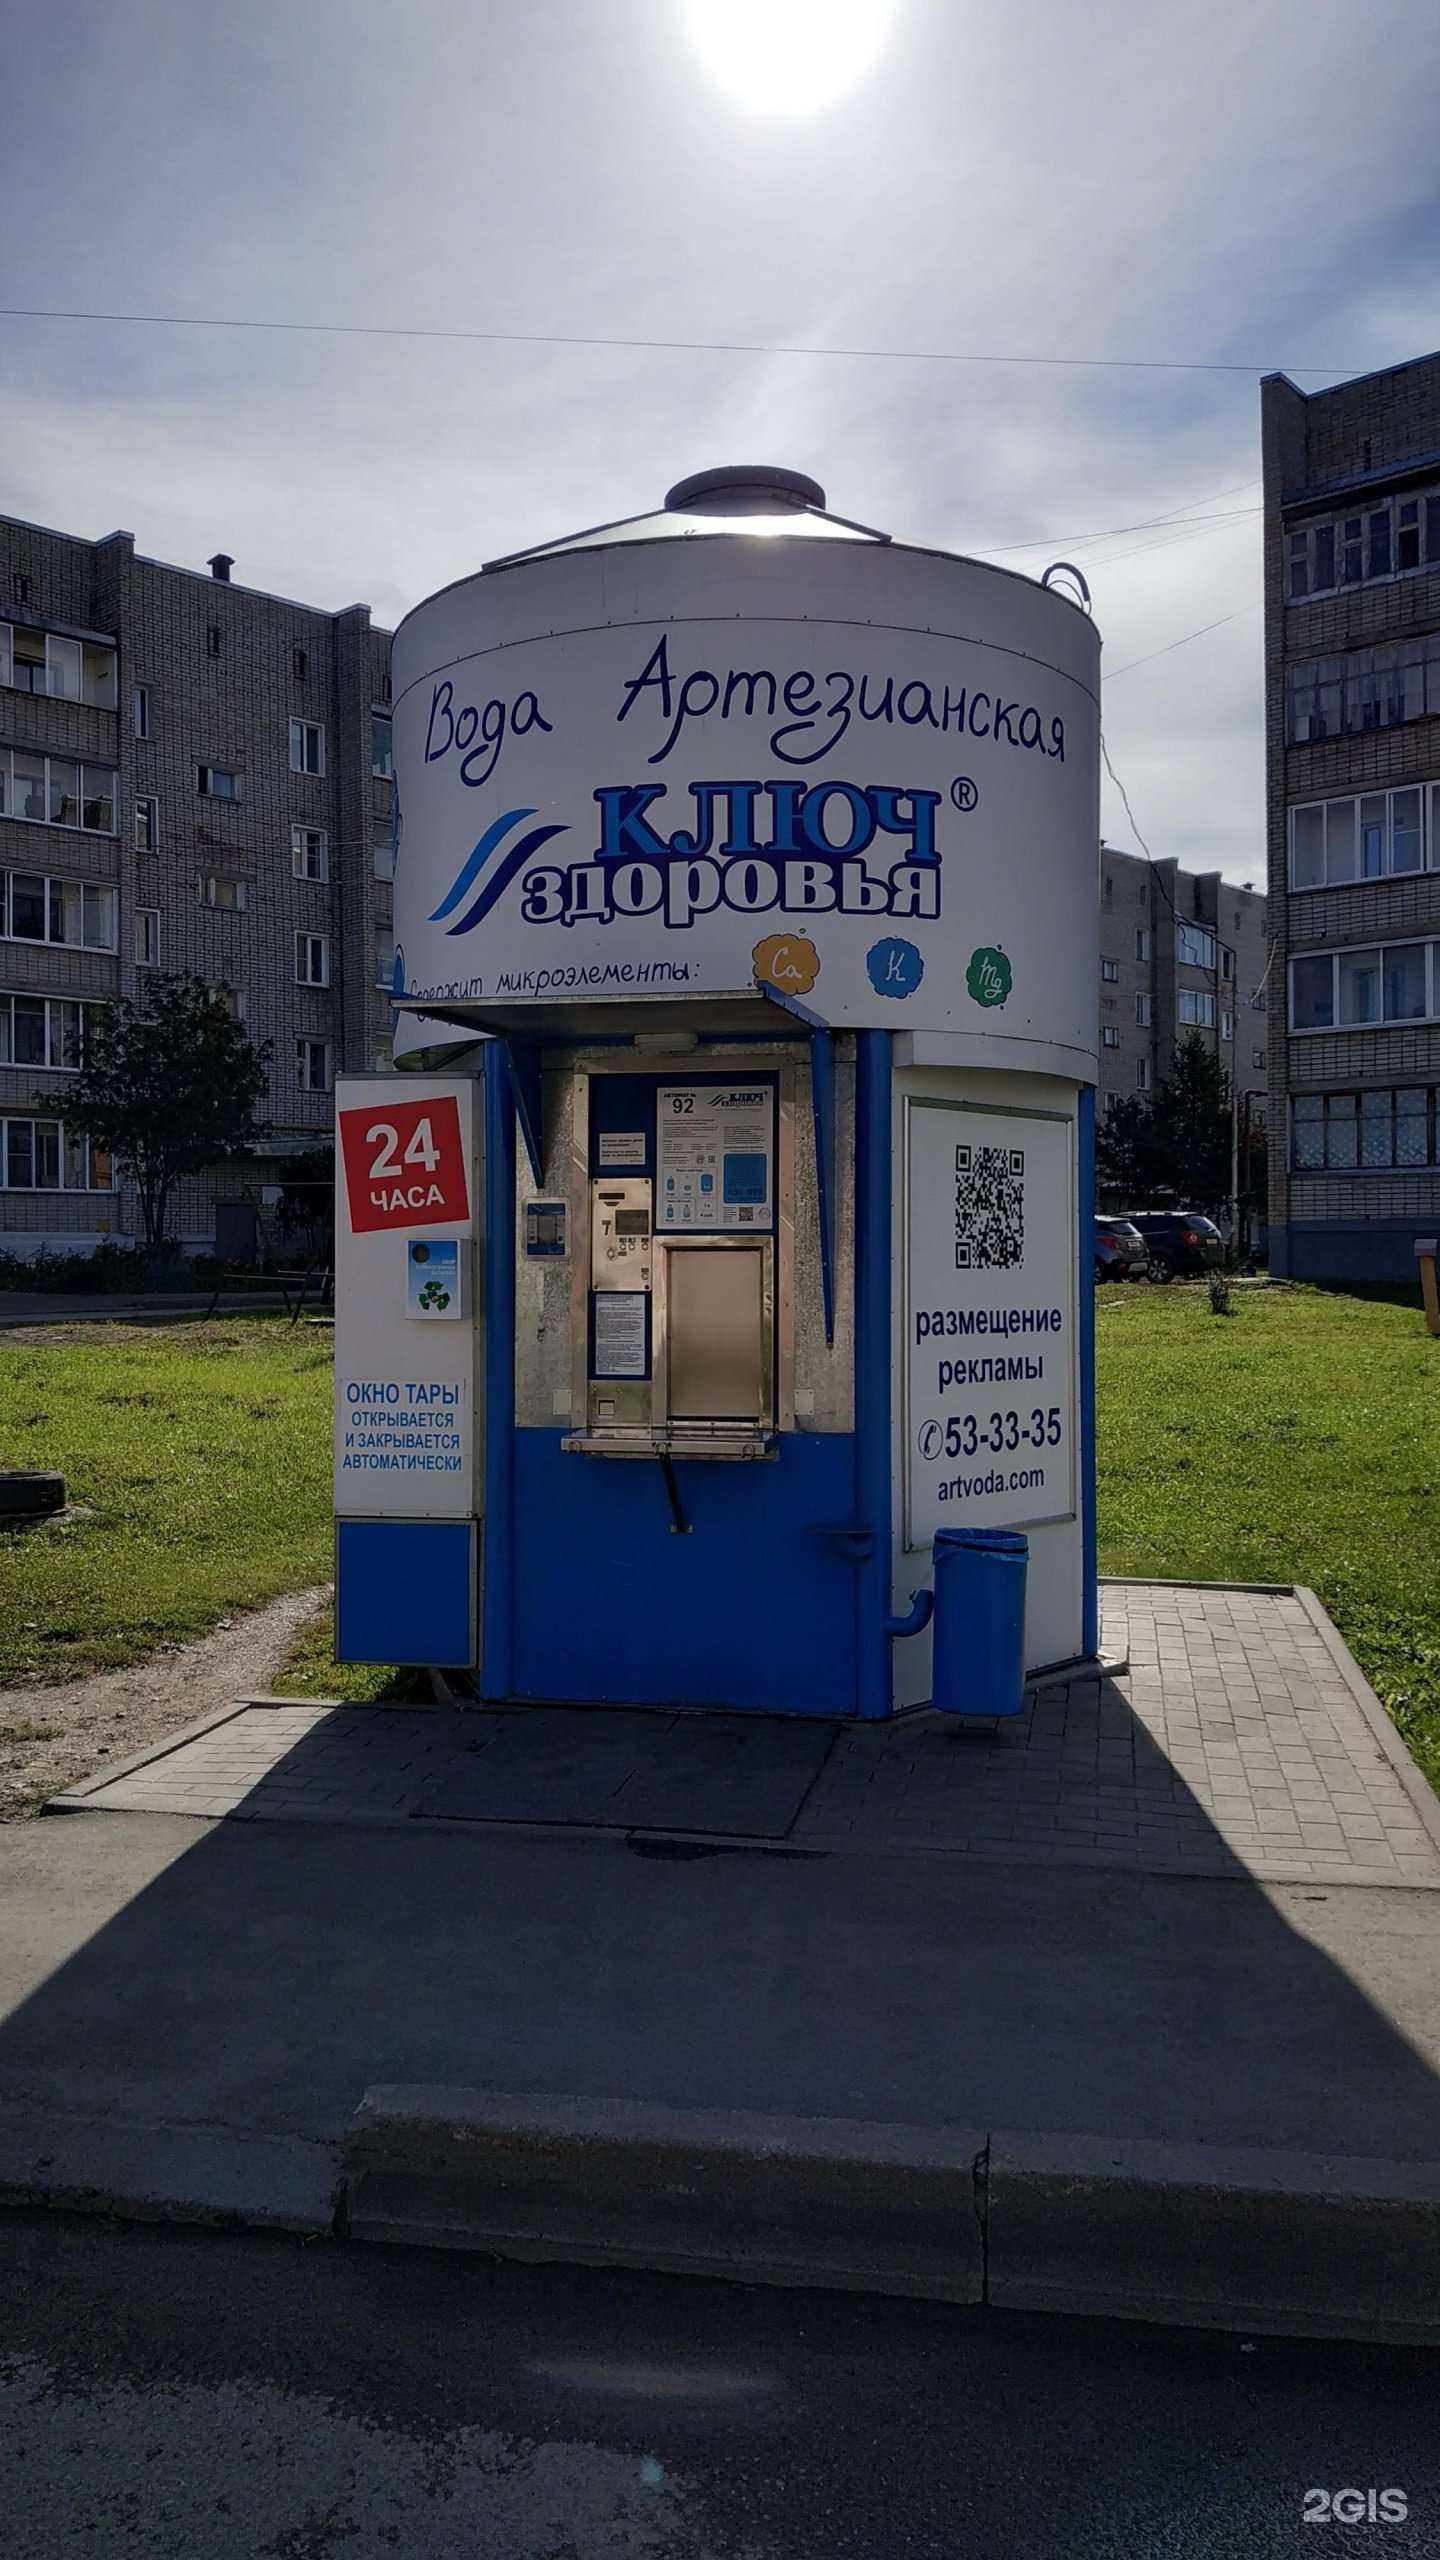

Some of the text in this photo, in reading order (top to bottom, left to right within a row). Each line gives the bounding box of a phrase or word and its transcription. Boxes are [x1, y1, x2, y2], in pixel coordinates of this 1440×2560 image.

[425, 633, 1066, 788] Вода Артезианская
[495, 961, 703, 996] микроэлементы:
[771, 946, 803, 979] Ca
[672, 1098, 694, 1114] 92
[365, 1117, 441, 1179] 24
[370, 1183, 446, 1212] ЧАСА
[915, 1307, 1063, 1345] размещение
[938, 1353, 1044, 1394] рекламы
[346, 1382, 460, 1405] ОКНО ТАРЫ
[351, 1411, 455, 1428] ОТКРЫВАЕТСЯ
[944, 1407, 1062, 1459] 53-33-35
[345, 1431, 461, 1450] И ЗАКРЫВАЕТСЯ
[342, 1453, 462, 1471] АВТОМАТИЧЕСКИ
[937, 1466, 1045, 1502] artvoda.com
